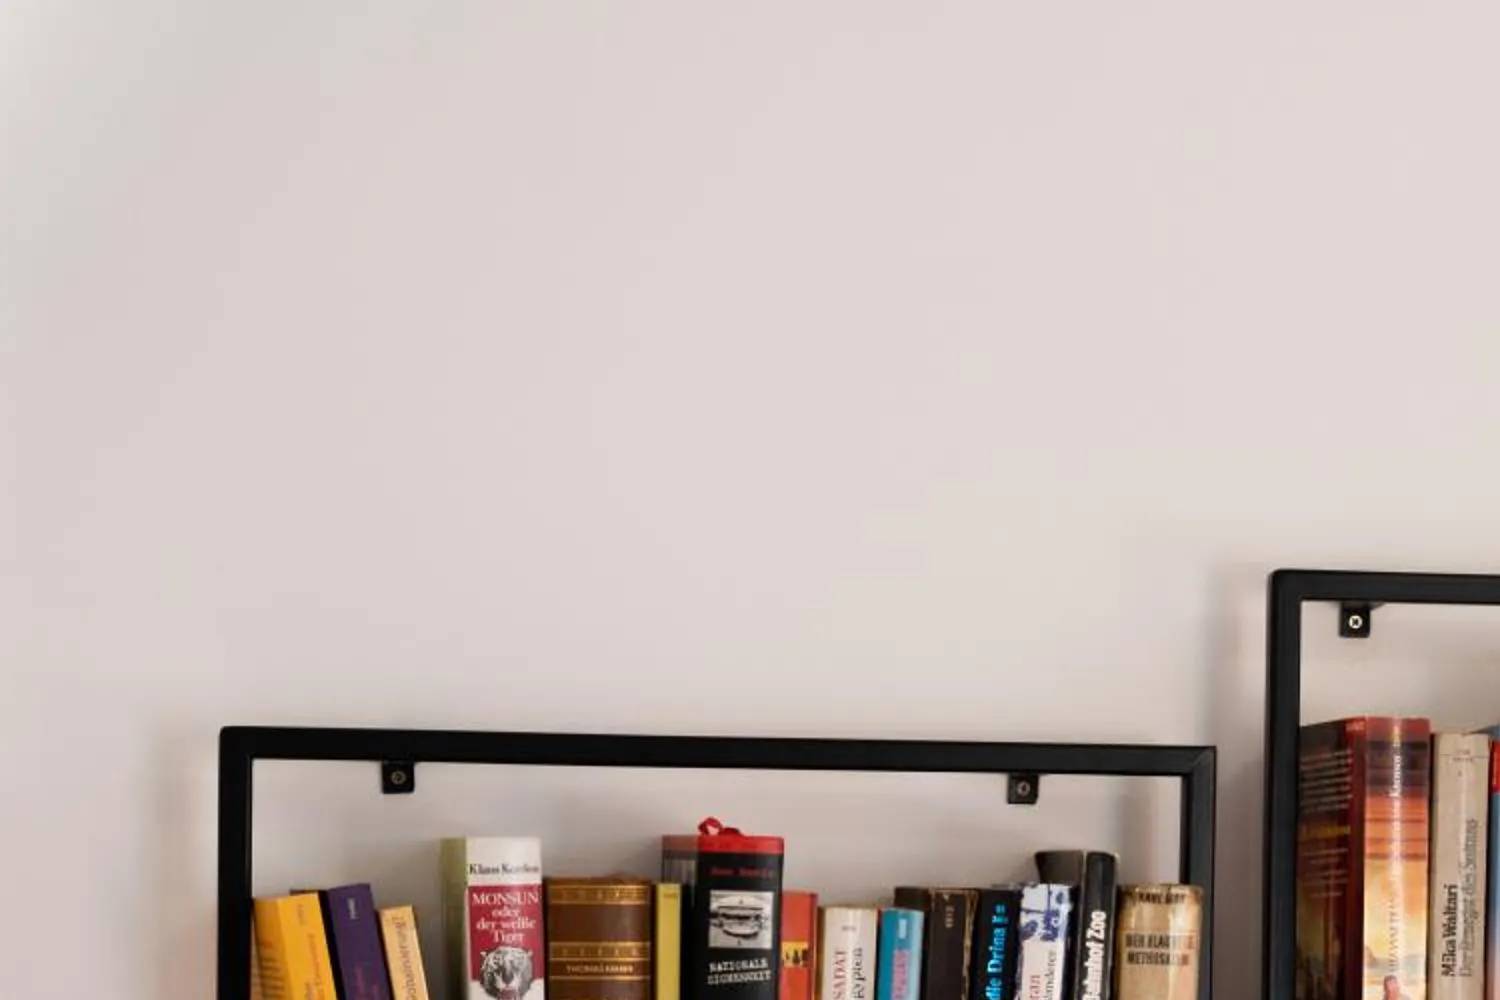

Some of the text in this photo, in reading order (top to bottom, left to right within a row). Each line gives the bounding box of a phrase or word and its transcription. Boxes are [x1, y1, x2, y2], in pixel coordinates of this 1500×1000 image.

[472, 891, 540, 905] MONSUN
[491, 906, 521, 918] oder
[476, 918, 496, 931] der
[1086, 911, 1107, 941] Zoo
[1441, 883, 1458, 977] Mika Waltari
[493, 930, 525, 944] Tiger
[987, 927, 1007, 973] Drina
[834, 949, 848, 1000] SADAT
[986, 977, 1002, 1000] die
